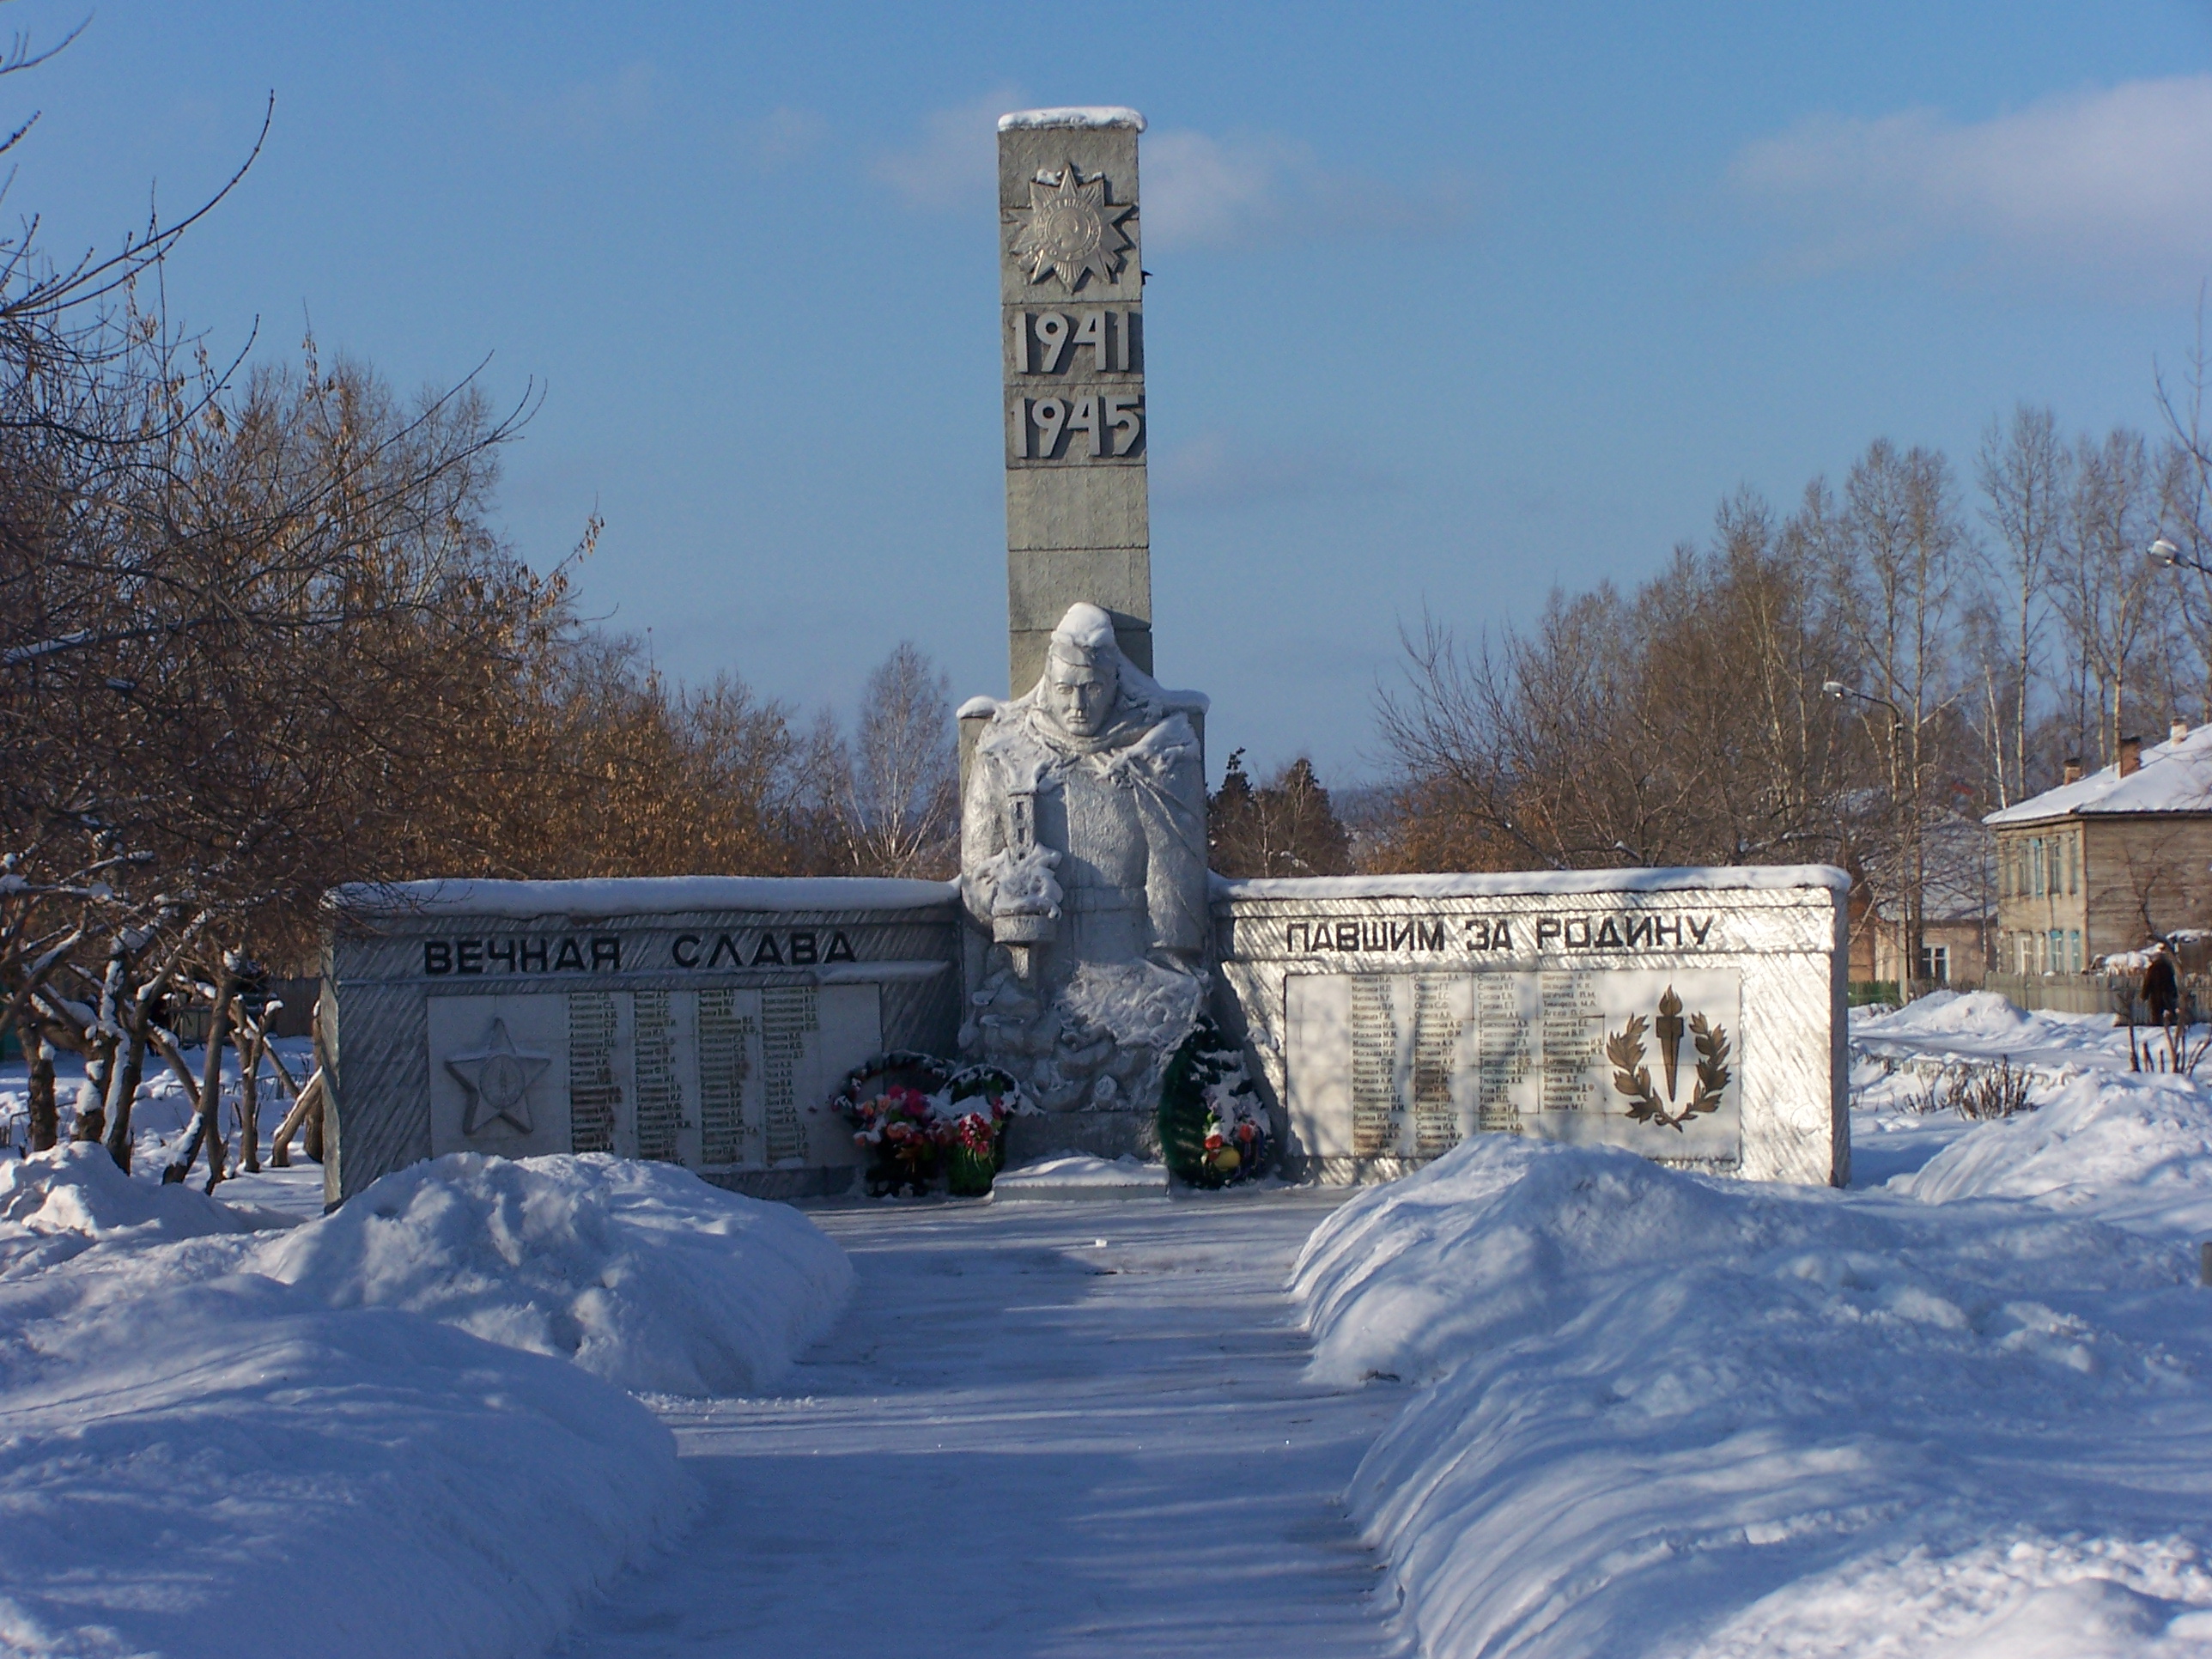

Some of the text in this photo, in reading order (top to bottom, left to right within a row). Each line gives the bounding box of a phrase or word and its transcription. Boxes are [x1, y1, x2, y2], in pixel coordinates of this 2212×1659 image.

[1012, 310, 1130, 374] 1941
[1011, 394, 1141, 459] 1945
[423, 931, 856, 975] ВЕЧНАЯ СЛАВА
[1288, 915, 1714, 952] ПАВШИМ ЗА РОДИНУ
